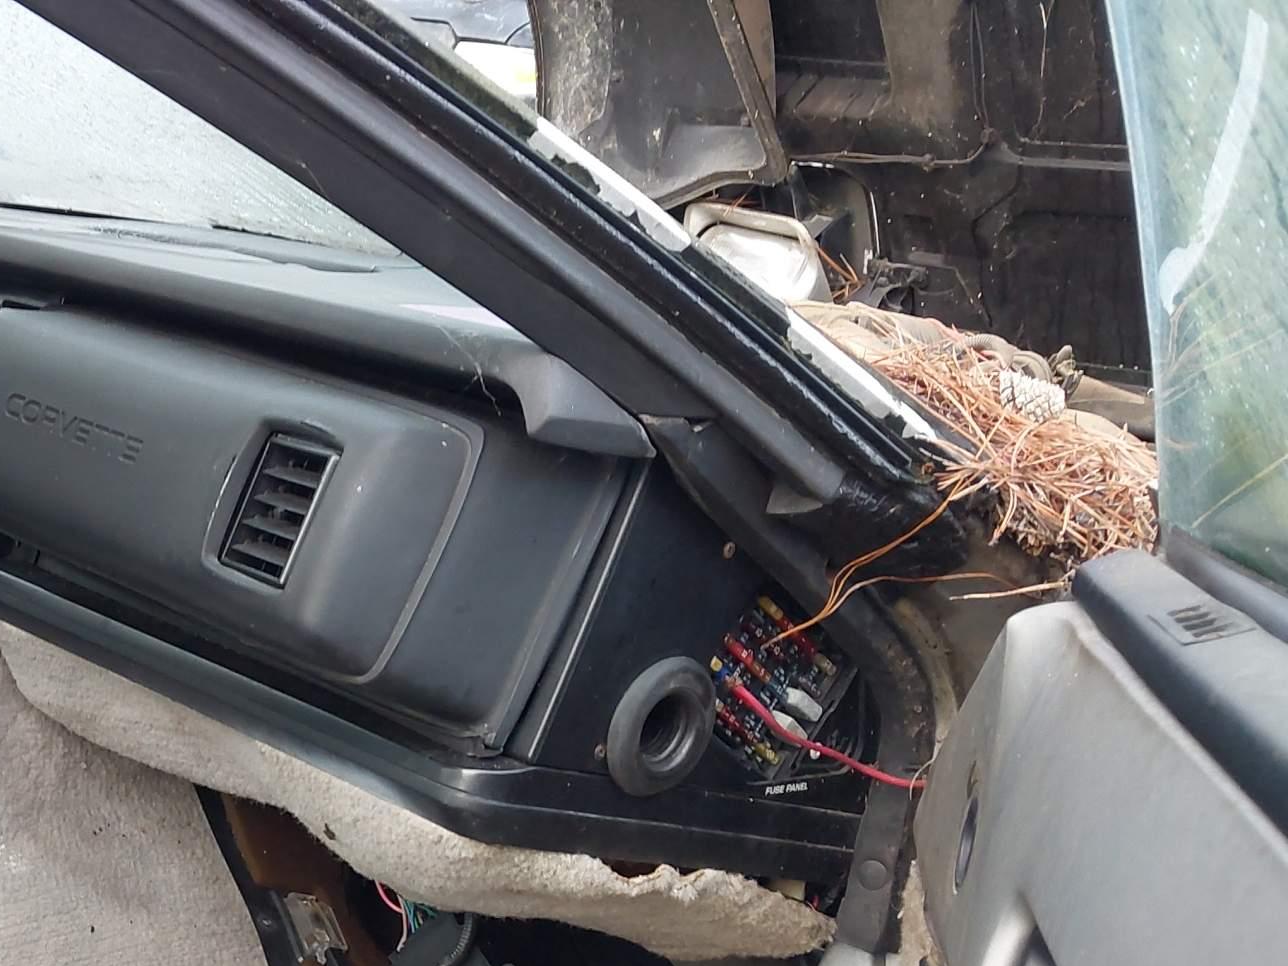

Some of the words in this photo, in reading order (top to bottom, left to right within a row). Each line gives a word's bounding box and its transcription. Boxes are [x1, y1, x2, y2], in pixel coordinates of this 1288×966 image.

[6, 392, 144, 464] CORVETTE
[765, 785, 785, 796] FUSE
[786, 781, 808, 792] PANEL
